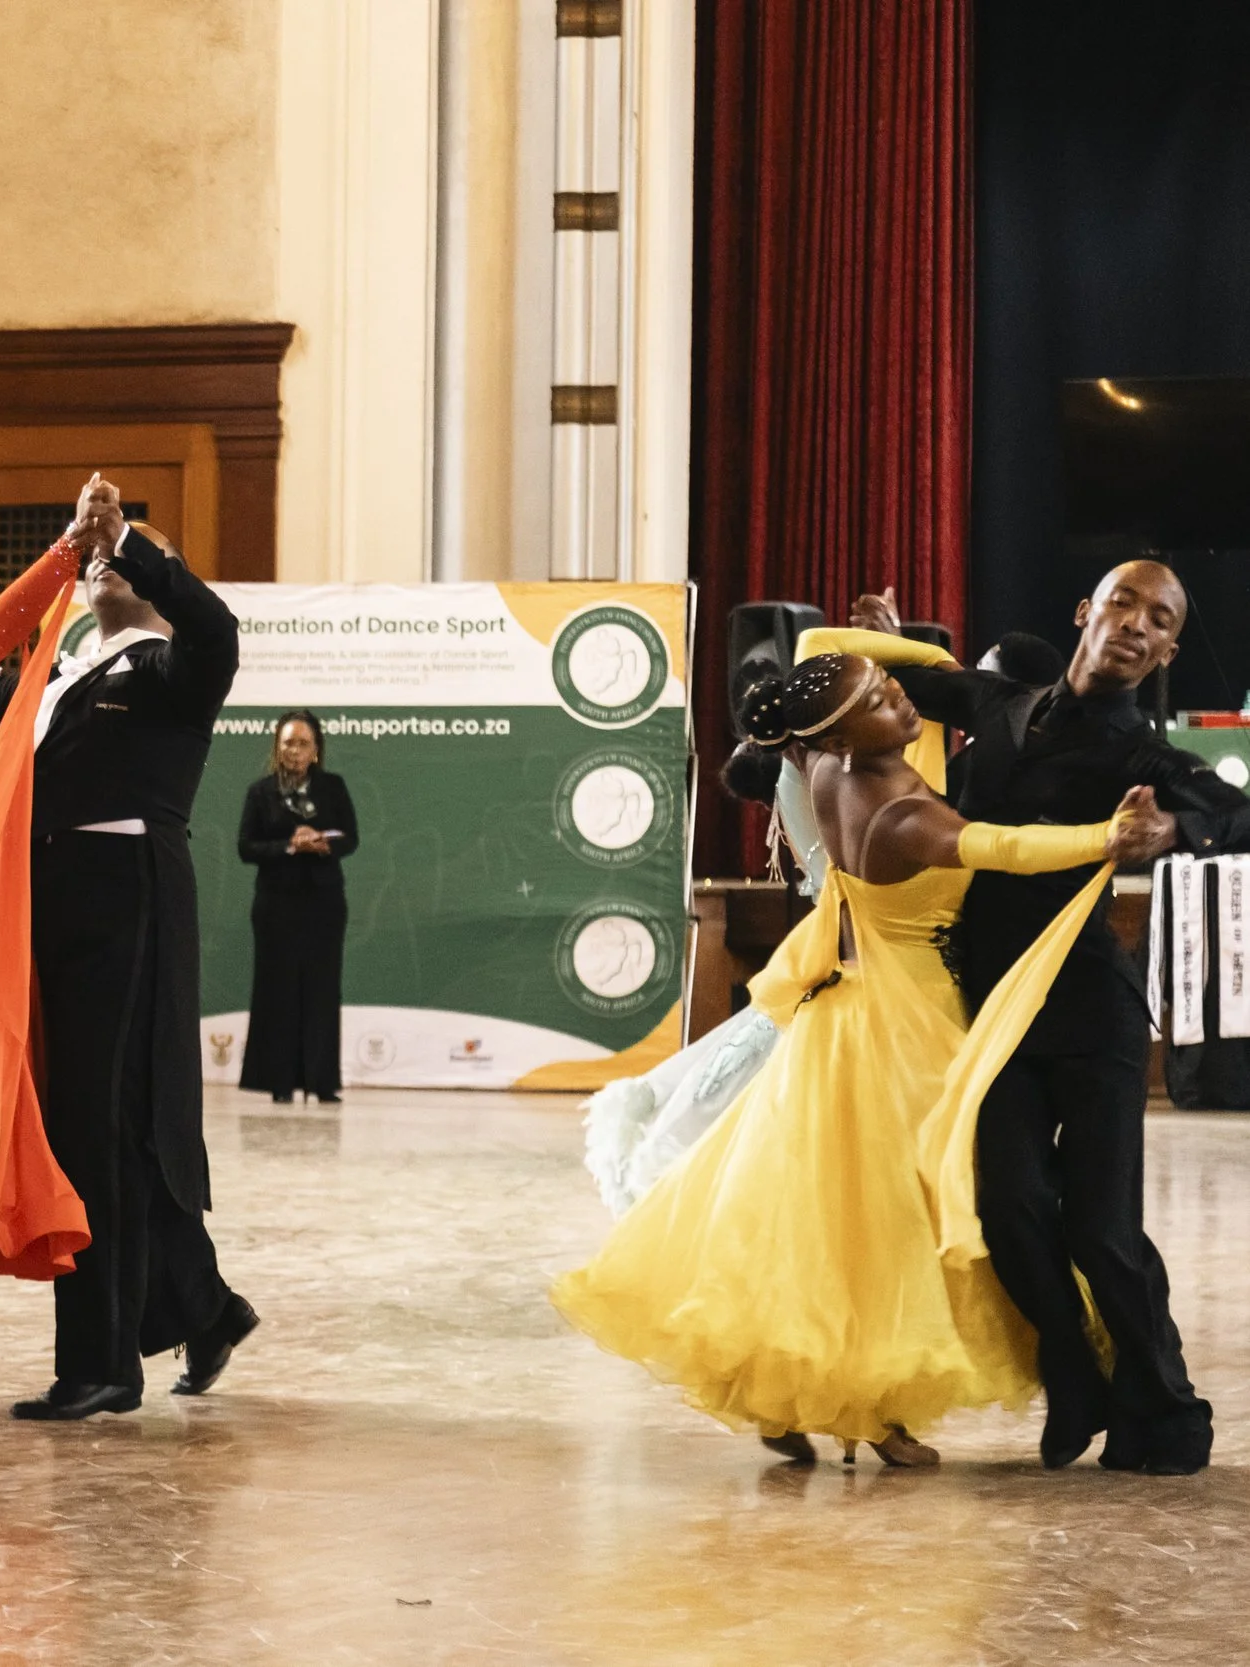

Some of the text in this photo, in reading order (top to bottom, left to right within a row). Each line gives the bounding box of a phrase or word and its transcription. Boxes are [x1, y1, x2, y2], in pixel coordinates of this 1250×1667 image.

[238, 616, 506, 640] deration of Dance Sport
[212, 714, 510, 740] www.einsportsa.co.za
[1229, 867, 1243, 921] QUEEN
